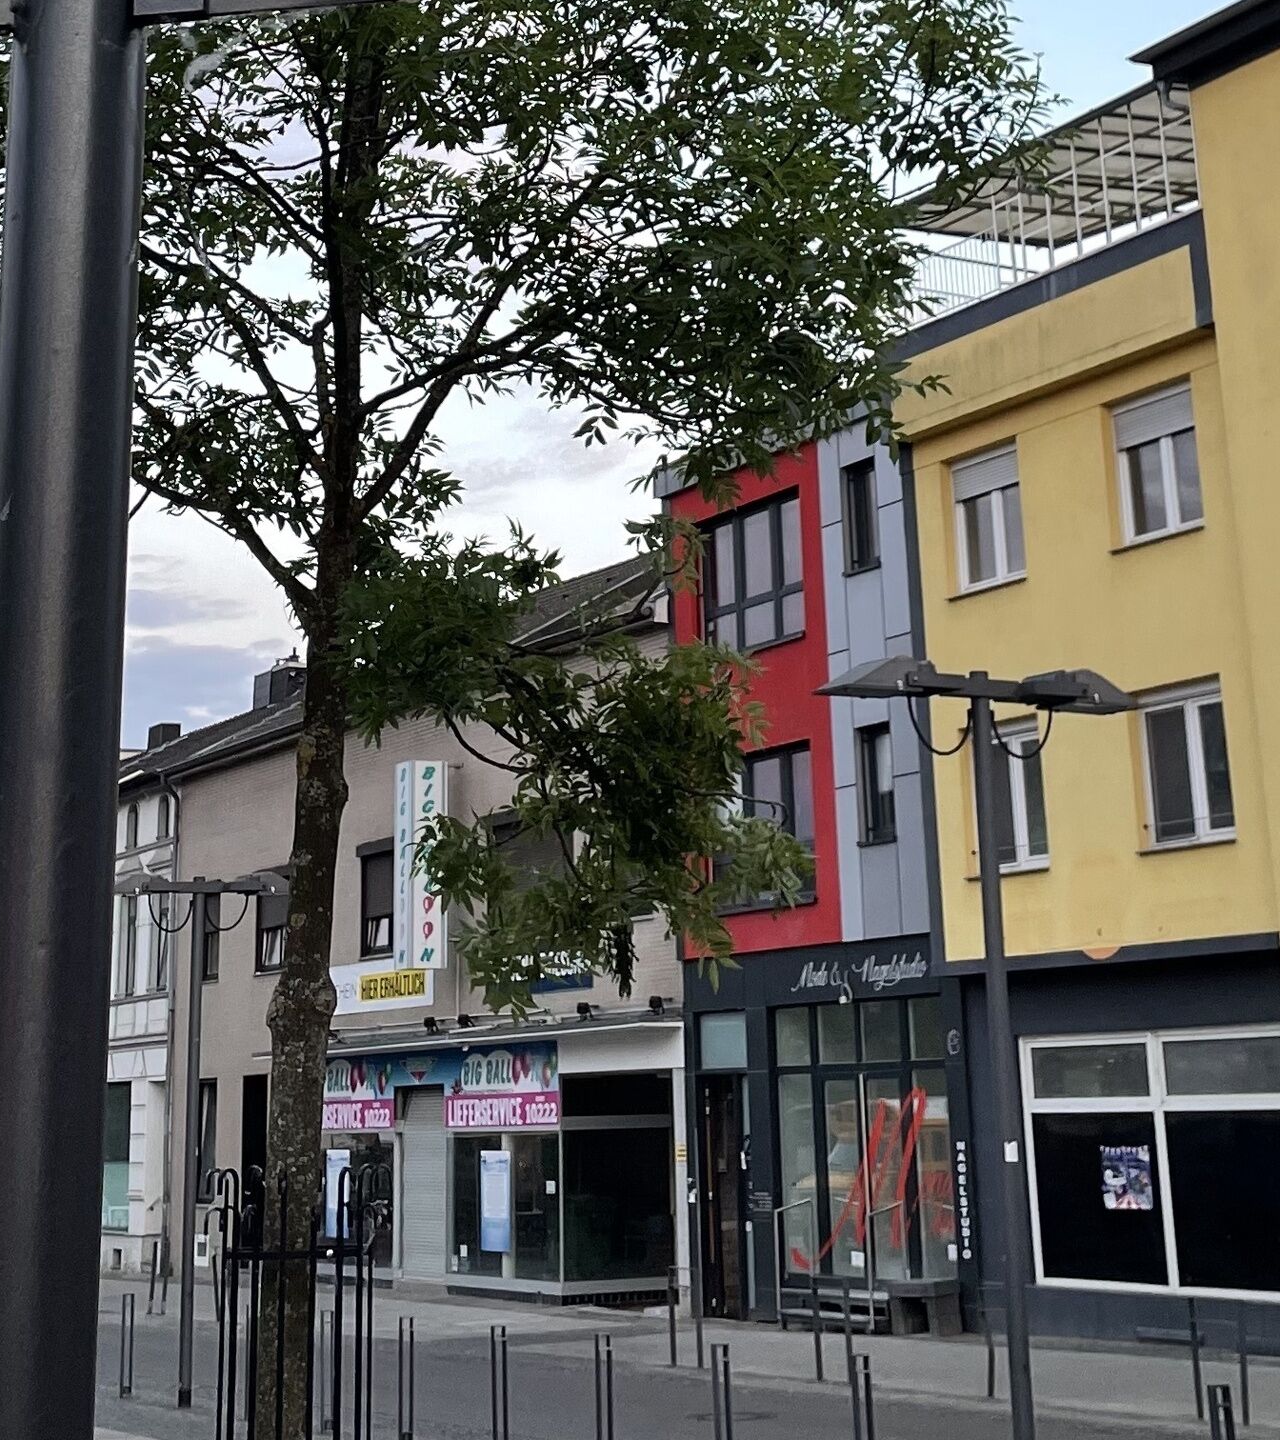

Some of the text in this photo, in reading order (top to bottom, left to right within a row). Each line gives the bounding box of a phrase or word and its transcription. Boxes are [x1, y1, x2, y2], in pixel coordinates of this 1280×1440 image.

[422, 766, 436, 814] BIG
[464, 1060, 482, 1086] BIG
[448, 1097, 558, 1127] LIEFERSERVICE 10222
[956, 1141, 972, 1259] NAGELSTUDIO
